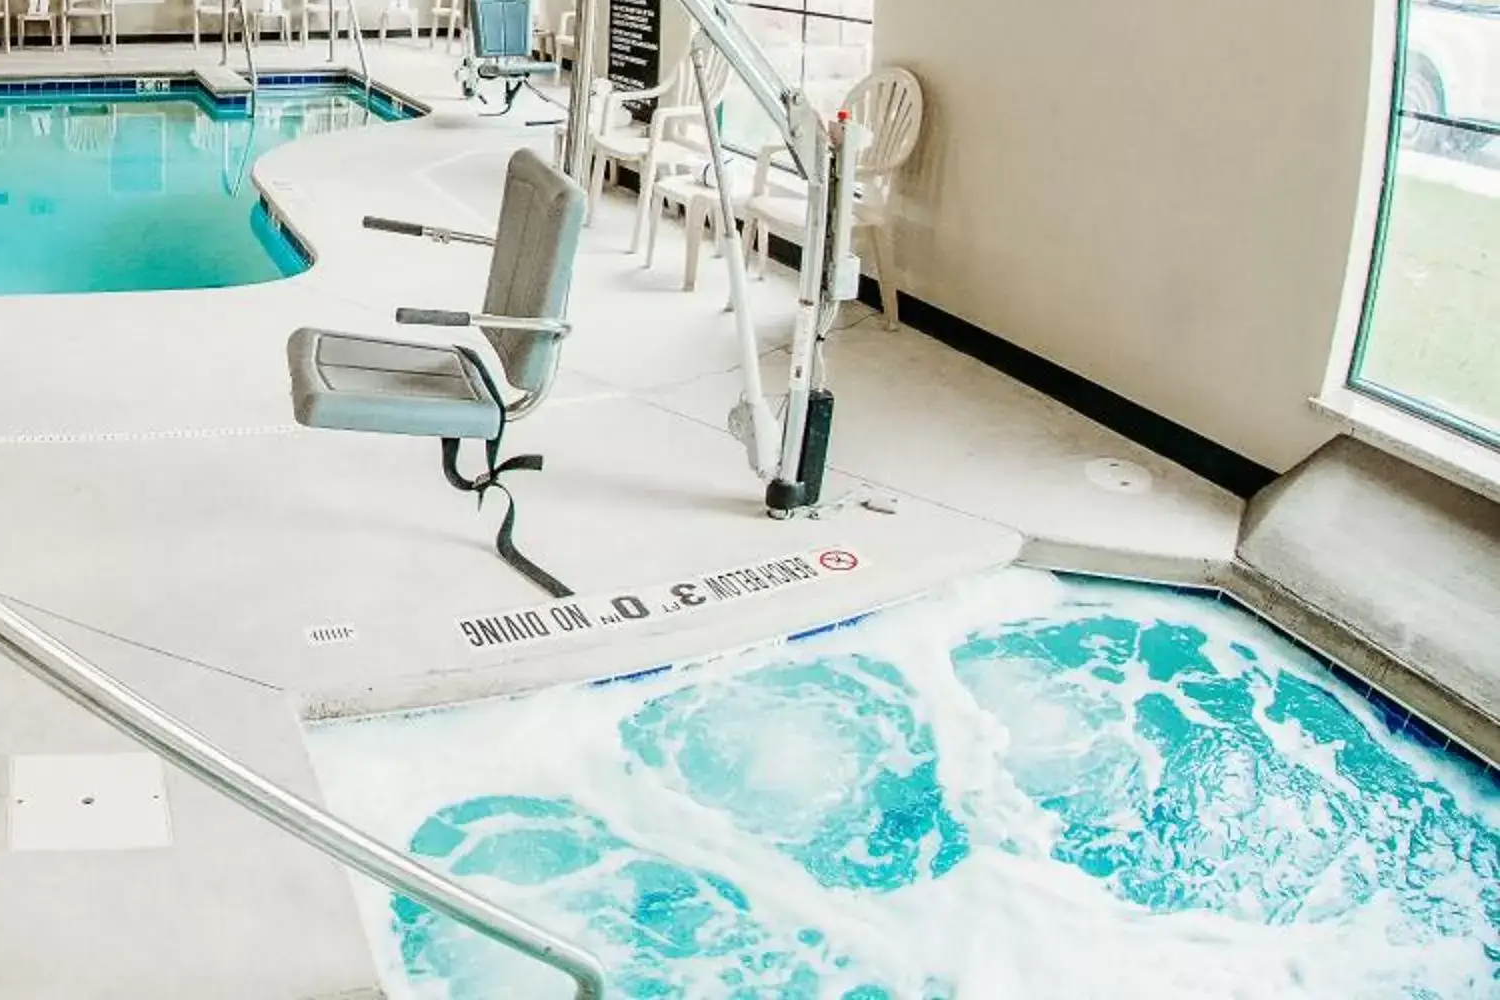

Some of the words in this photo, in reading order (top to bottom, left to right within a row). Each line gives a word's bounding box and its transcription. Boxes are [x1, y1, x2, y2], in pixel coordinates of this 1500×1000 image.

[704, 566, 763, 601] BELOW
[762, 556, 818, 586] BENCH
[670, 583, 707, 607] 3
[460, 611, 550, 647] DIVING
[551, 603, 592, 631] NO
